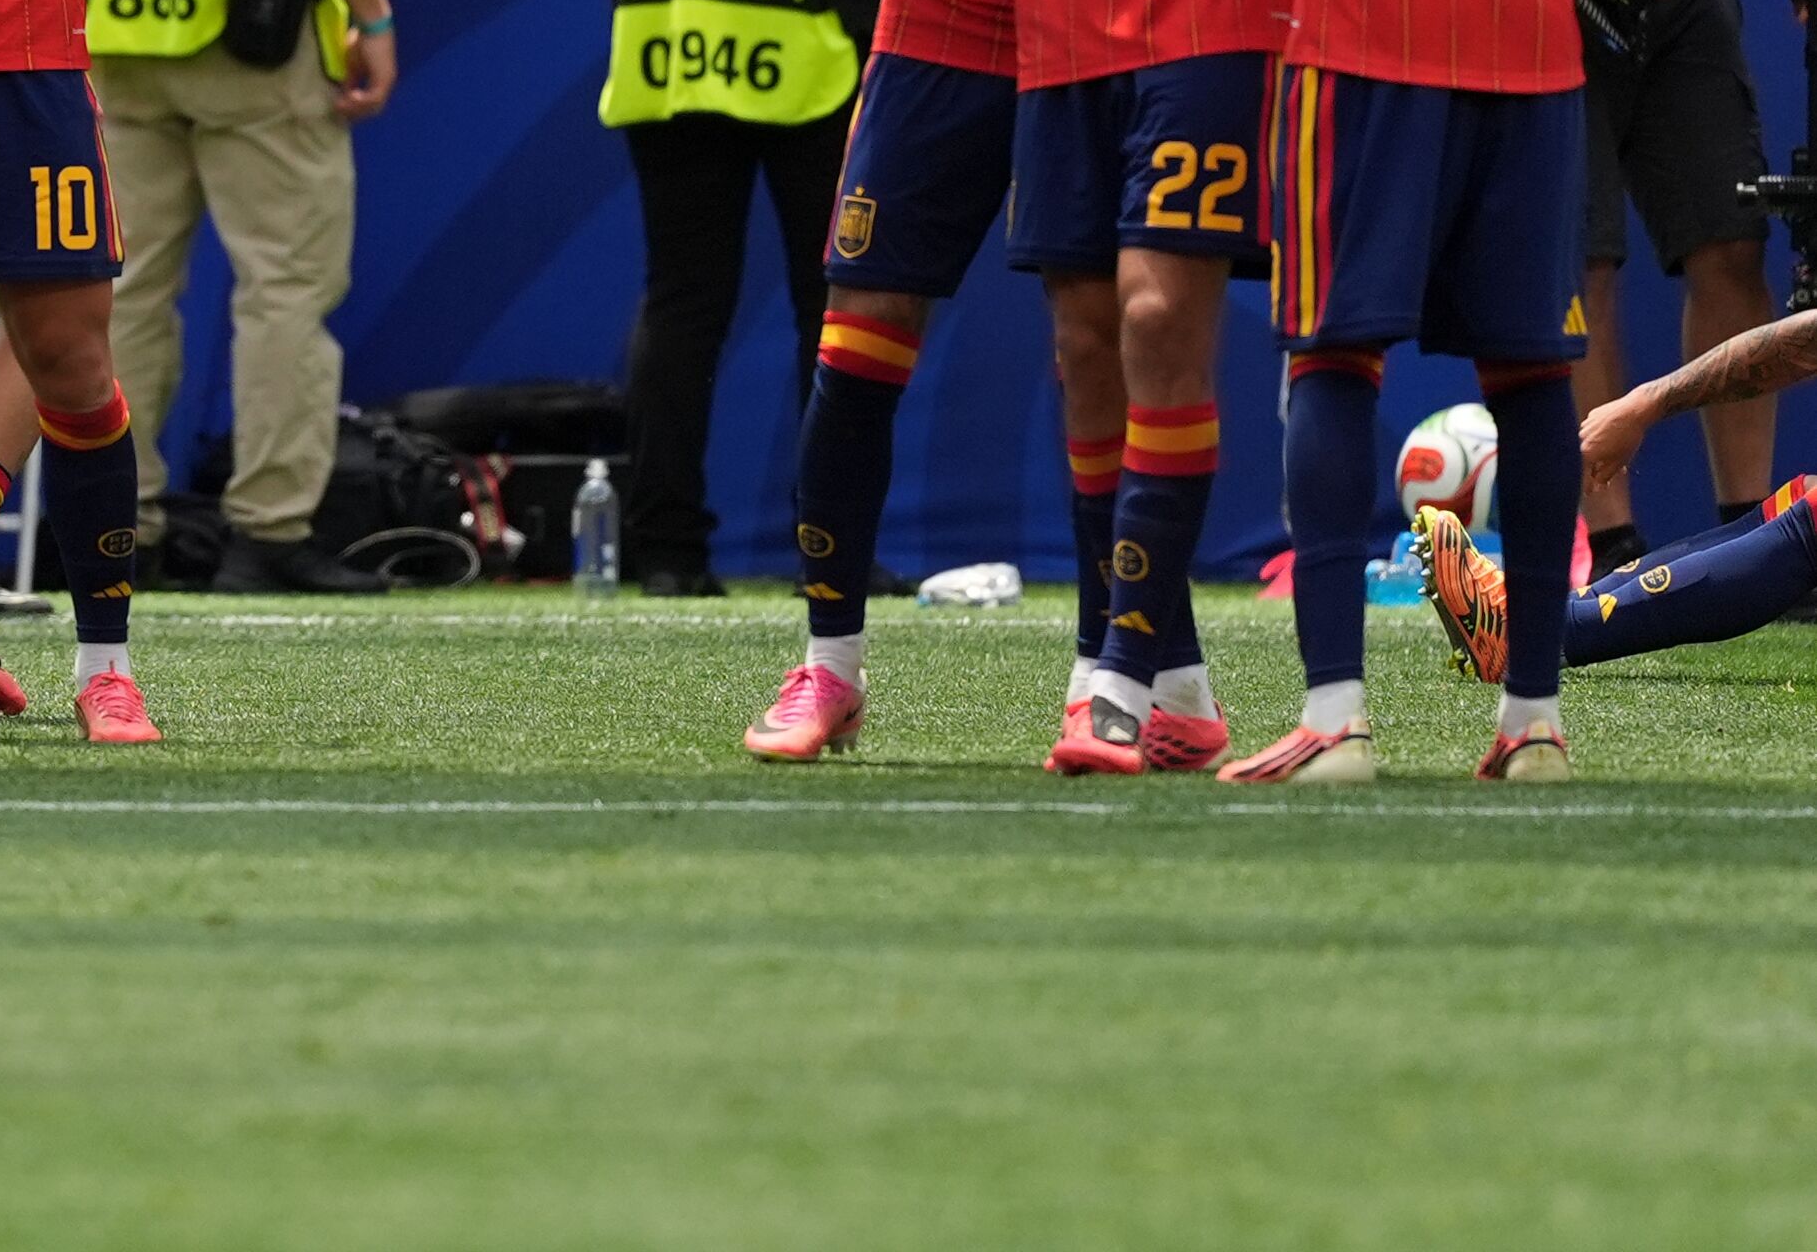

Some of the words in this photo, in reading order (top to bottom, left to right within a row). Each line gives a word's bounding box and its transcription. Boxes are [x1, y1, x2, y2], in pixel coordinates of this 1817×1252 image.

[640, 29, 784, 92] 0946
[29, 165, 97, 250] 10
[1145, 141, 1248, 232] 22
